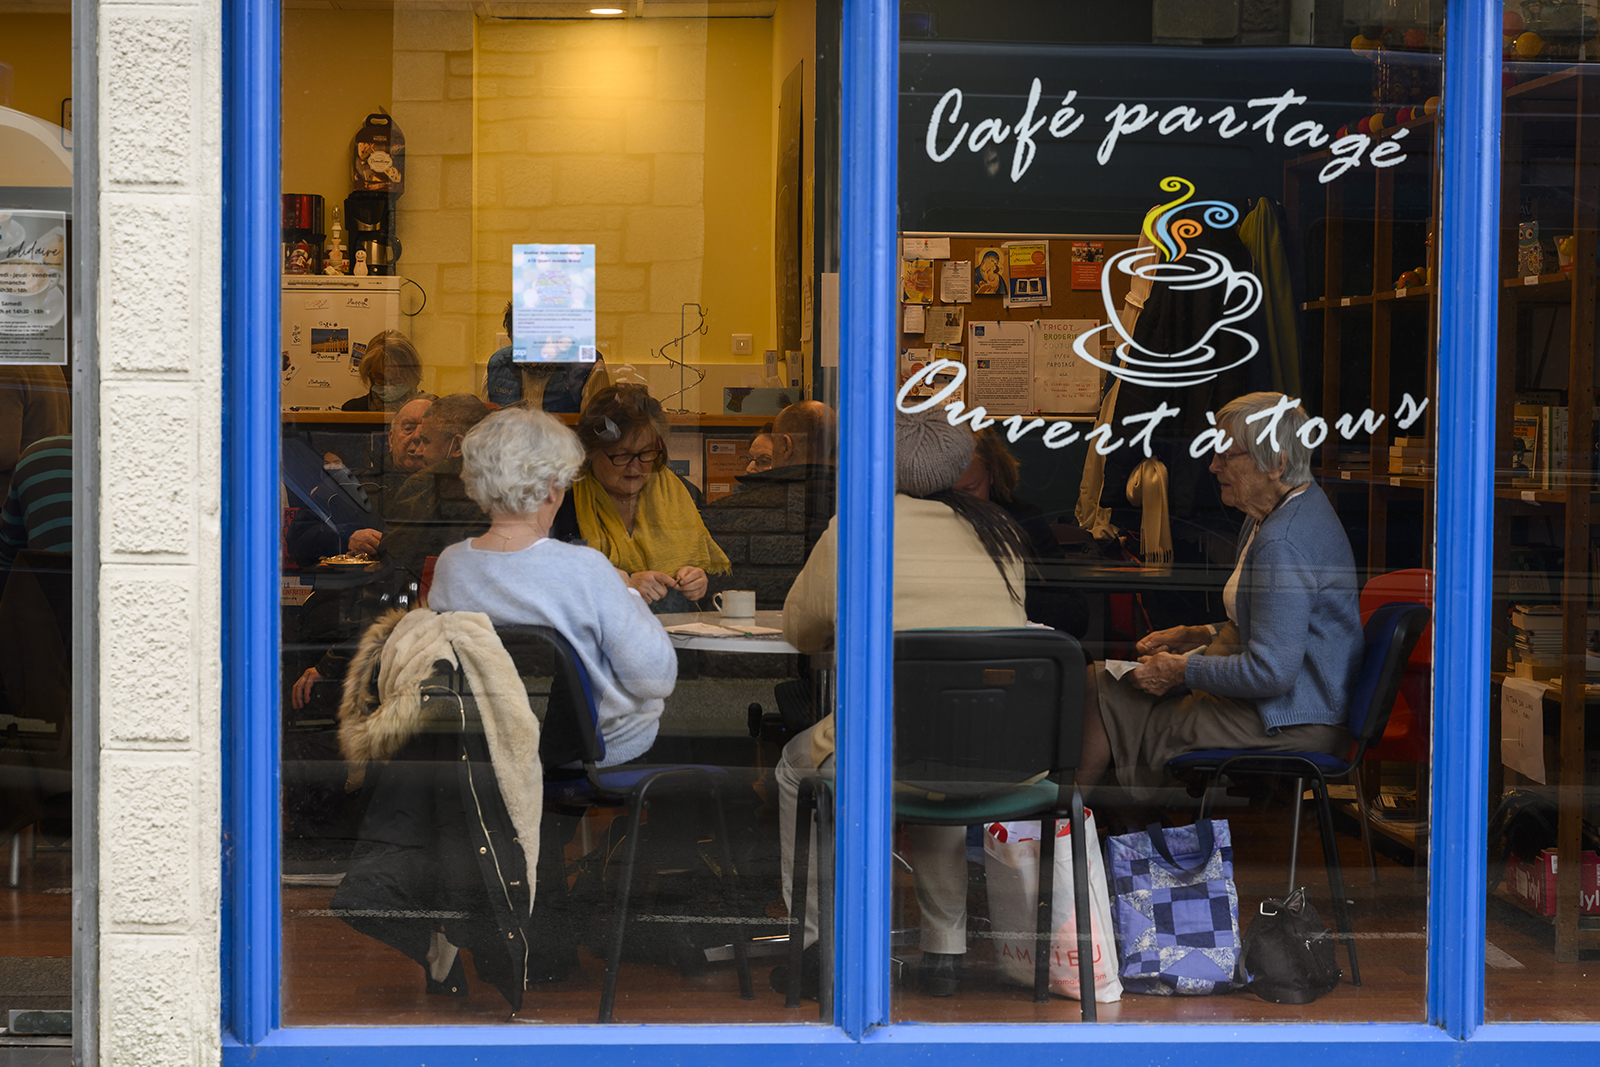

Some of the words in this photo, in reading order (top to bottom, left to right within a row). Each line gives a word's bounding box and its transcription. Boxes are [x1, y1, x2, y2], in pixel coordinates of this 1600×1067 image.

[927, 78, 1083, 182] Café
[1098, 89, 1409, 183] partagé
[6, 241, 61, 260] solidaire
[1043, 323, 1075, 331] TRICOT
[896, 359, 1180, 457] Ouvert
[1189, 411, 1234, 458] à
[1246, 394, 1429, 453] tous
